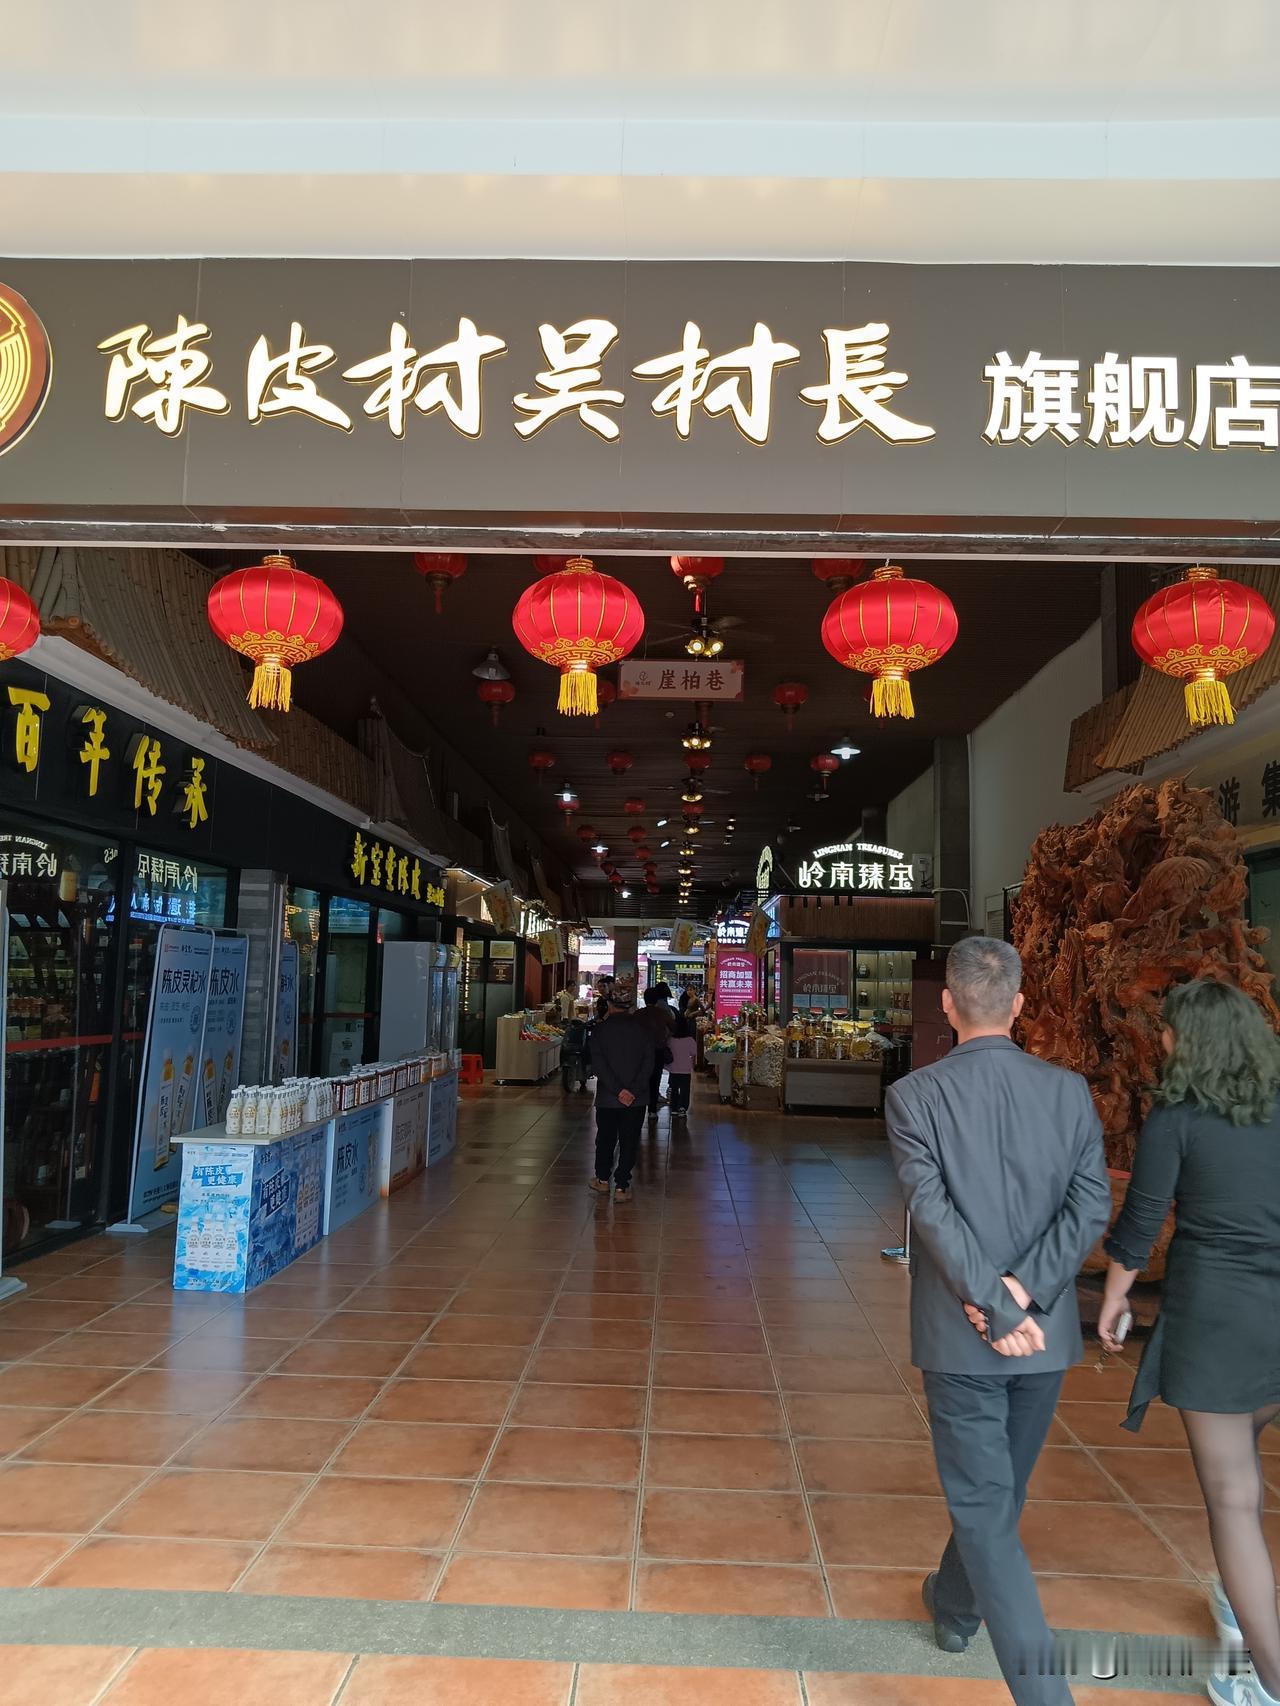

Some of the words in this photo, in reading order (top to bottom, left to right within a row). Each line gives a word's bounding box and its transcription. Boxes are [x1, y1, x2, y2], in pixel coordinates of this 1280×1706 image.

[982, 350, 1280, 448] 旗舰店
[658, 669, 724, 691] 崖柏巷
[7, 686, 209, 829] 百年传承
[813, 843, 853, 859] LINGNAN
[856, 843, 904, 860] TREASURES
[798, 861, 914, 890] 岭南臻宝
[719, 970, 753, 979] 招商加盟
[719, 980, 753, 989] 共赢未来
[195, 1166, 226, 1177] 有陈皮
[207, 1175, 238, 1186] 更健康
